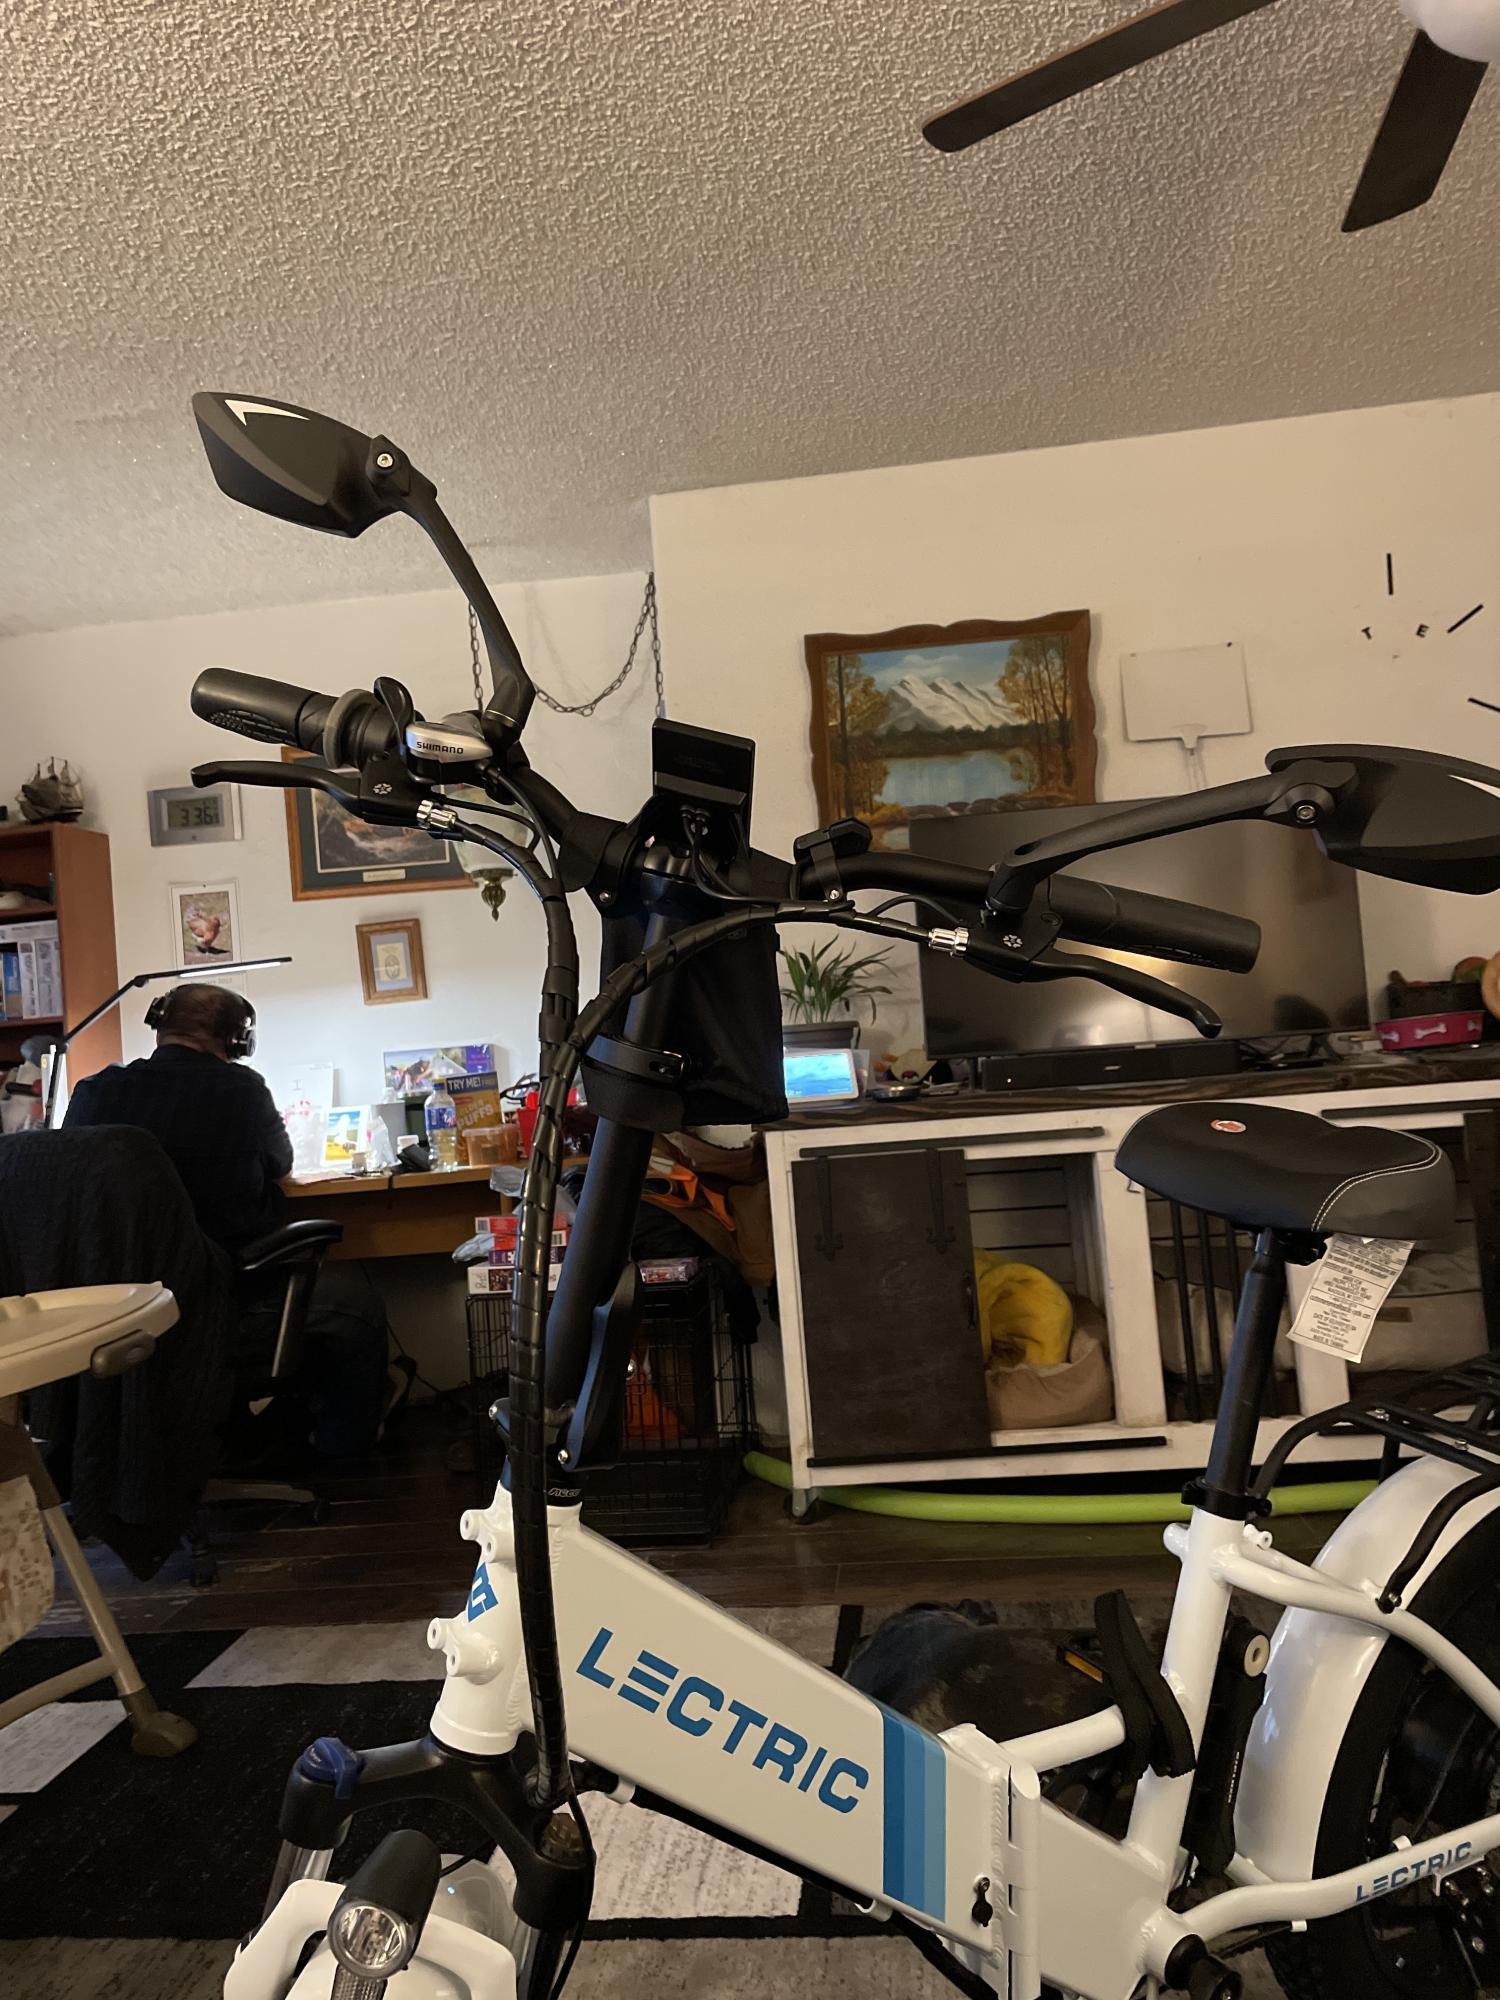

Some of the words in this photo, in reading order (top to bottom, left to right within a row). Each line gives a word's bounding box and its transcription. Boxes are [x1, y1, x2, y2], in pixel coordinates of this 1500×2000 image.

[1361, 626, 1372, 640] T
[1416, 623, 1430, 638] E
[416, 741, 464, 755] SHIMANO
[448, 1079, 465, 1091] TRY
[465, 1076, 480, 1088] ME!
[456, 1103, 494, 1130] PUFFS
[575, 1626, 870, 1814] LECTRIC
[1355, 1841, 1473, 1905] LECTRIC
